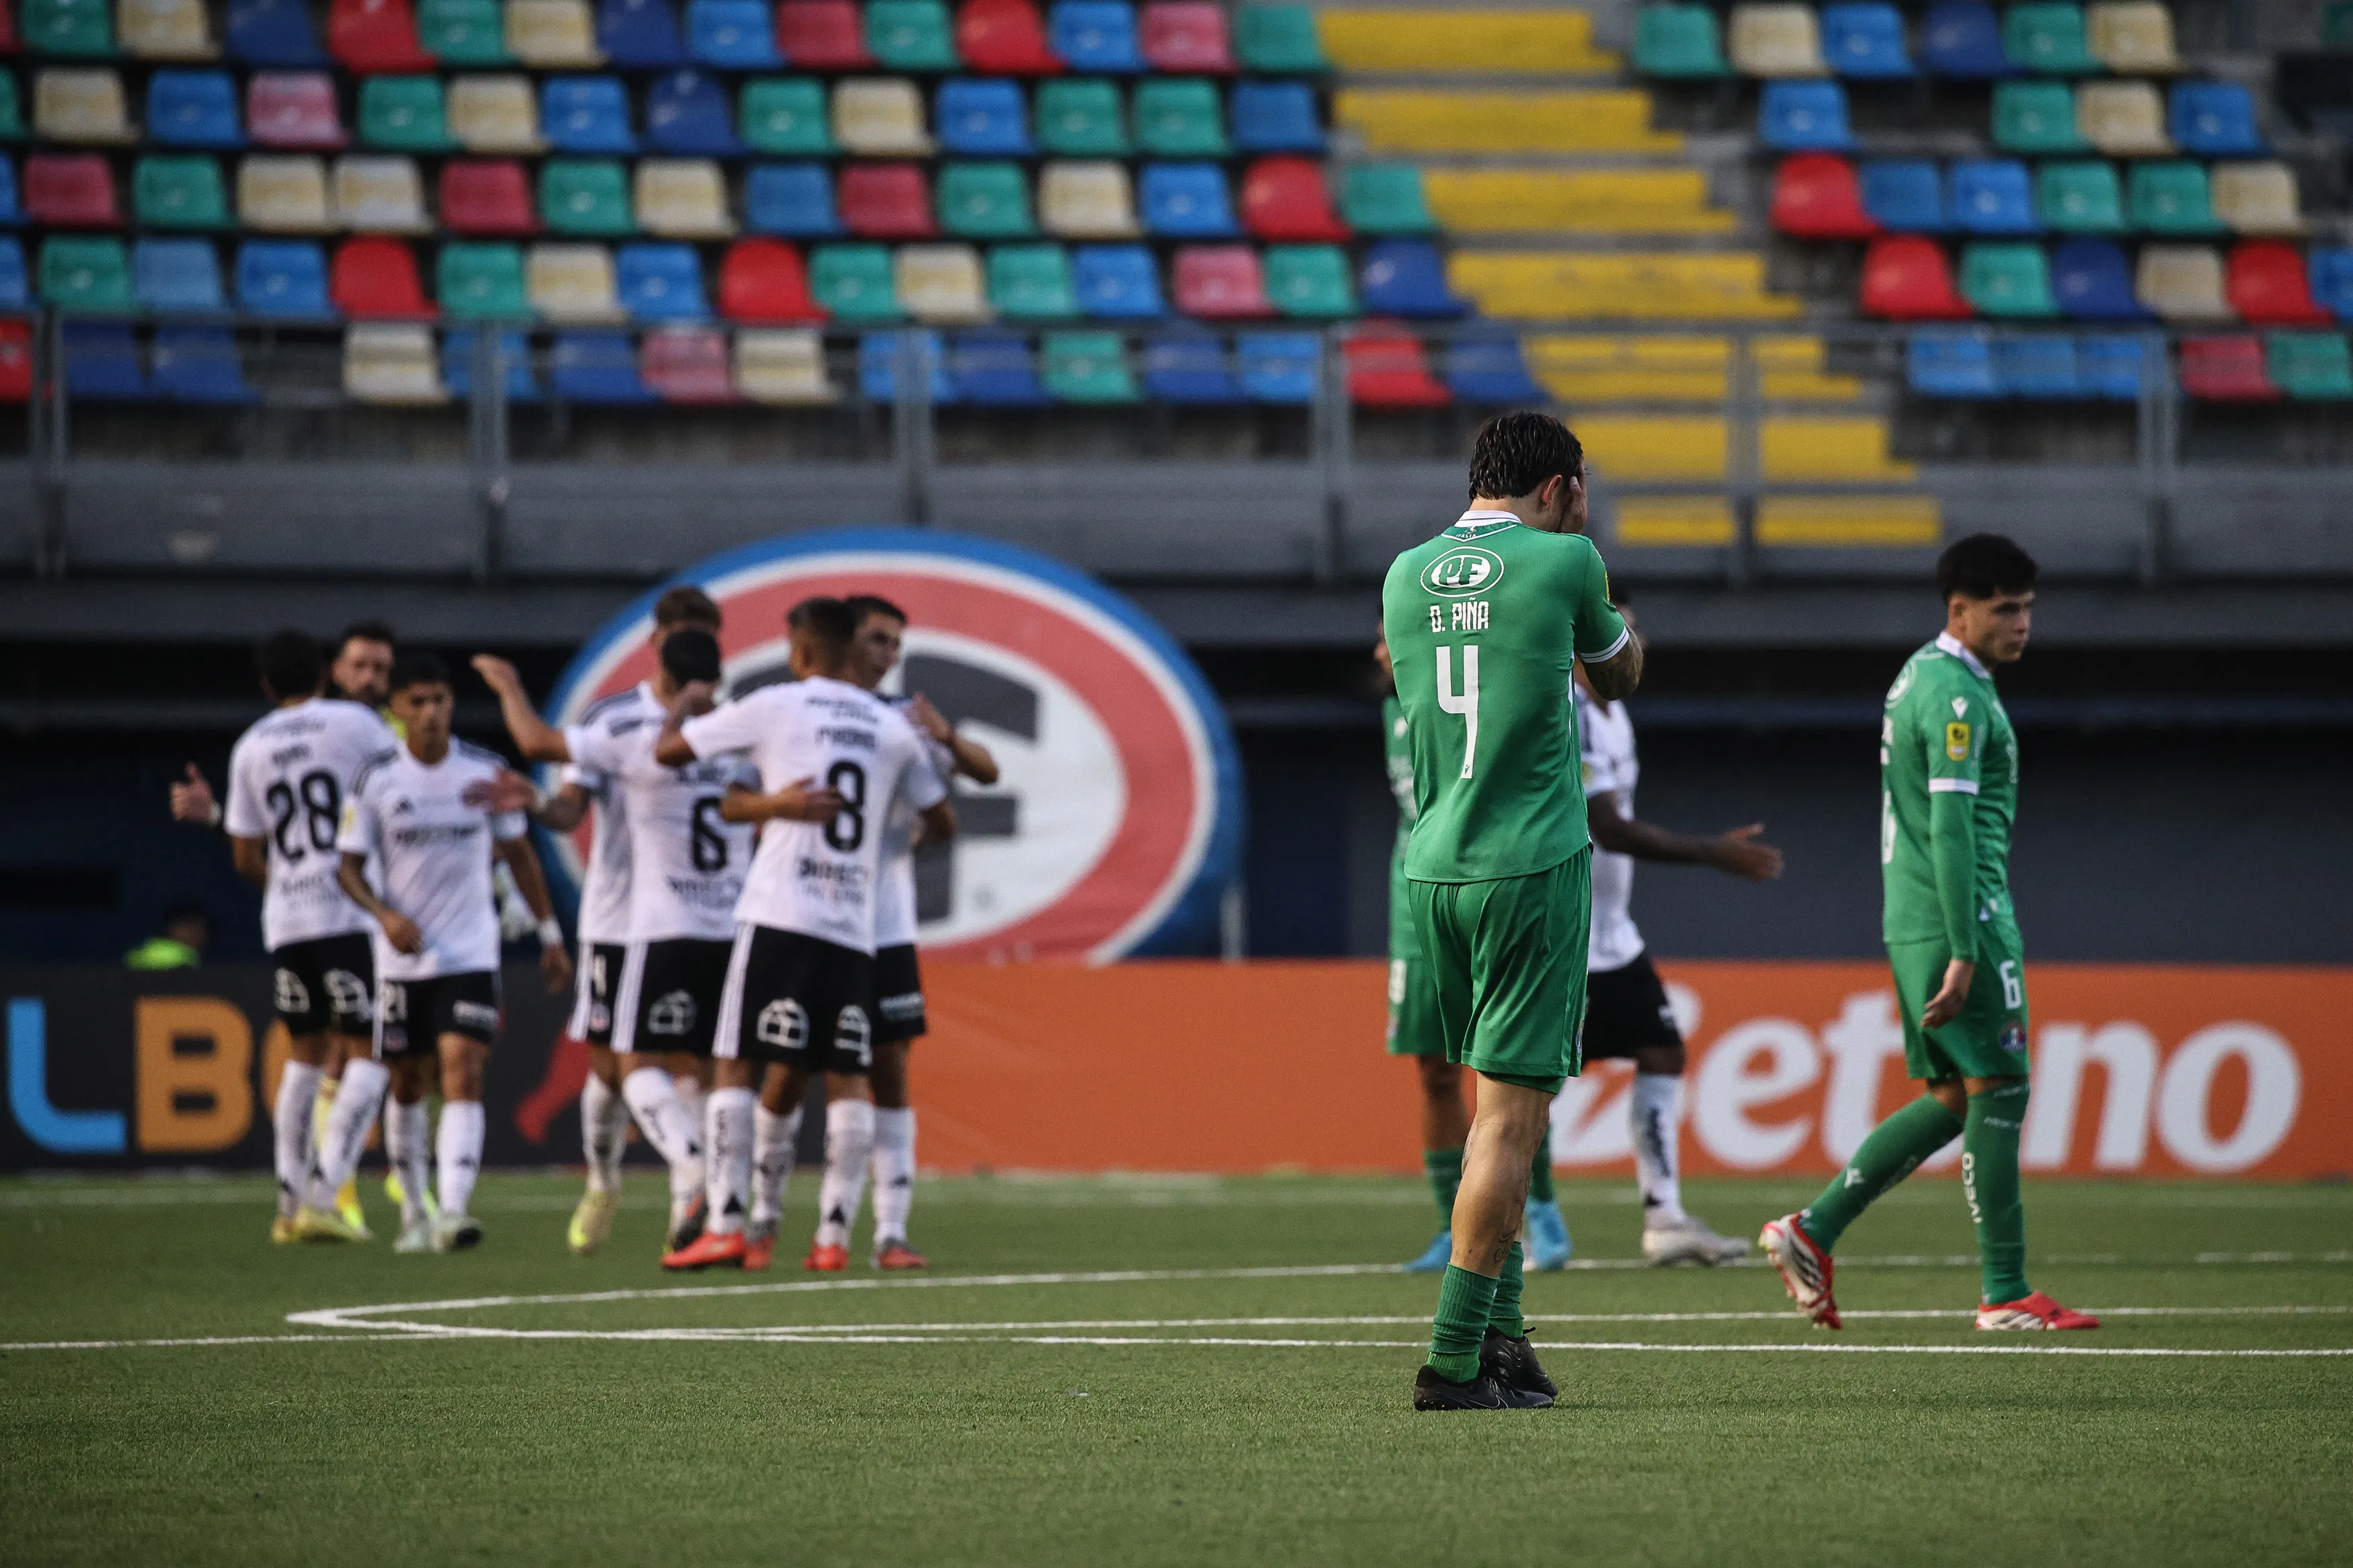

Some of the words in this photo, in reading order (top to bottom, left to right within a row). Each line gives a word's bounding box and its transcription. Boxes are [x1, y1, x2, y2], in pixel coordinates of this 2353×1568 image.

[1438, 557, 1483, 586] PF
[1429, 605, 1446, 633] D.
[1451, 597, 1490, 631] PIÑA
[1435, 645, 1479, 780] 4
[266, 770, 339, 862] 28
[692, 796, 727, 872] 6
[826, 759, 865, 853] 8
[1999, 959, 2022, 1009] 6
